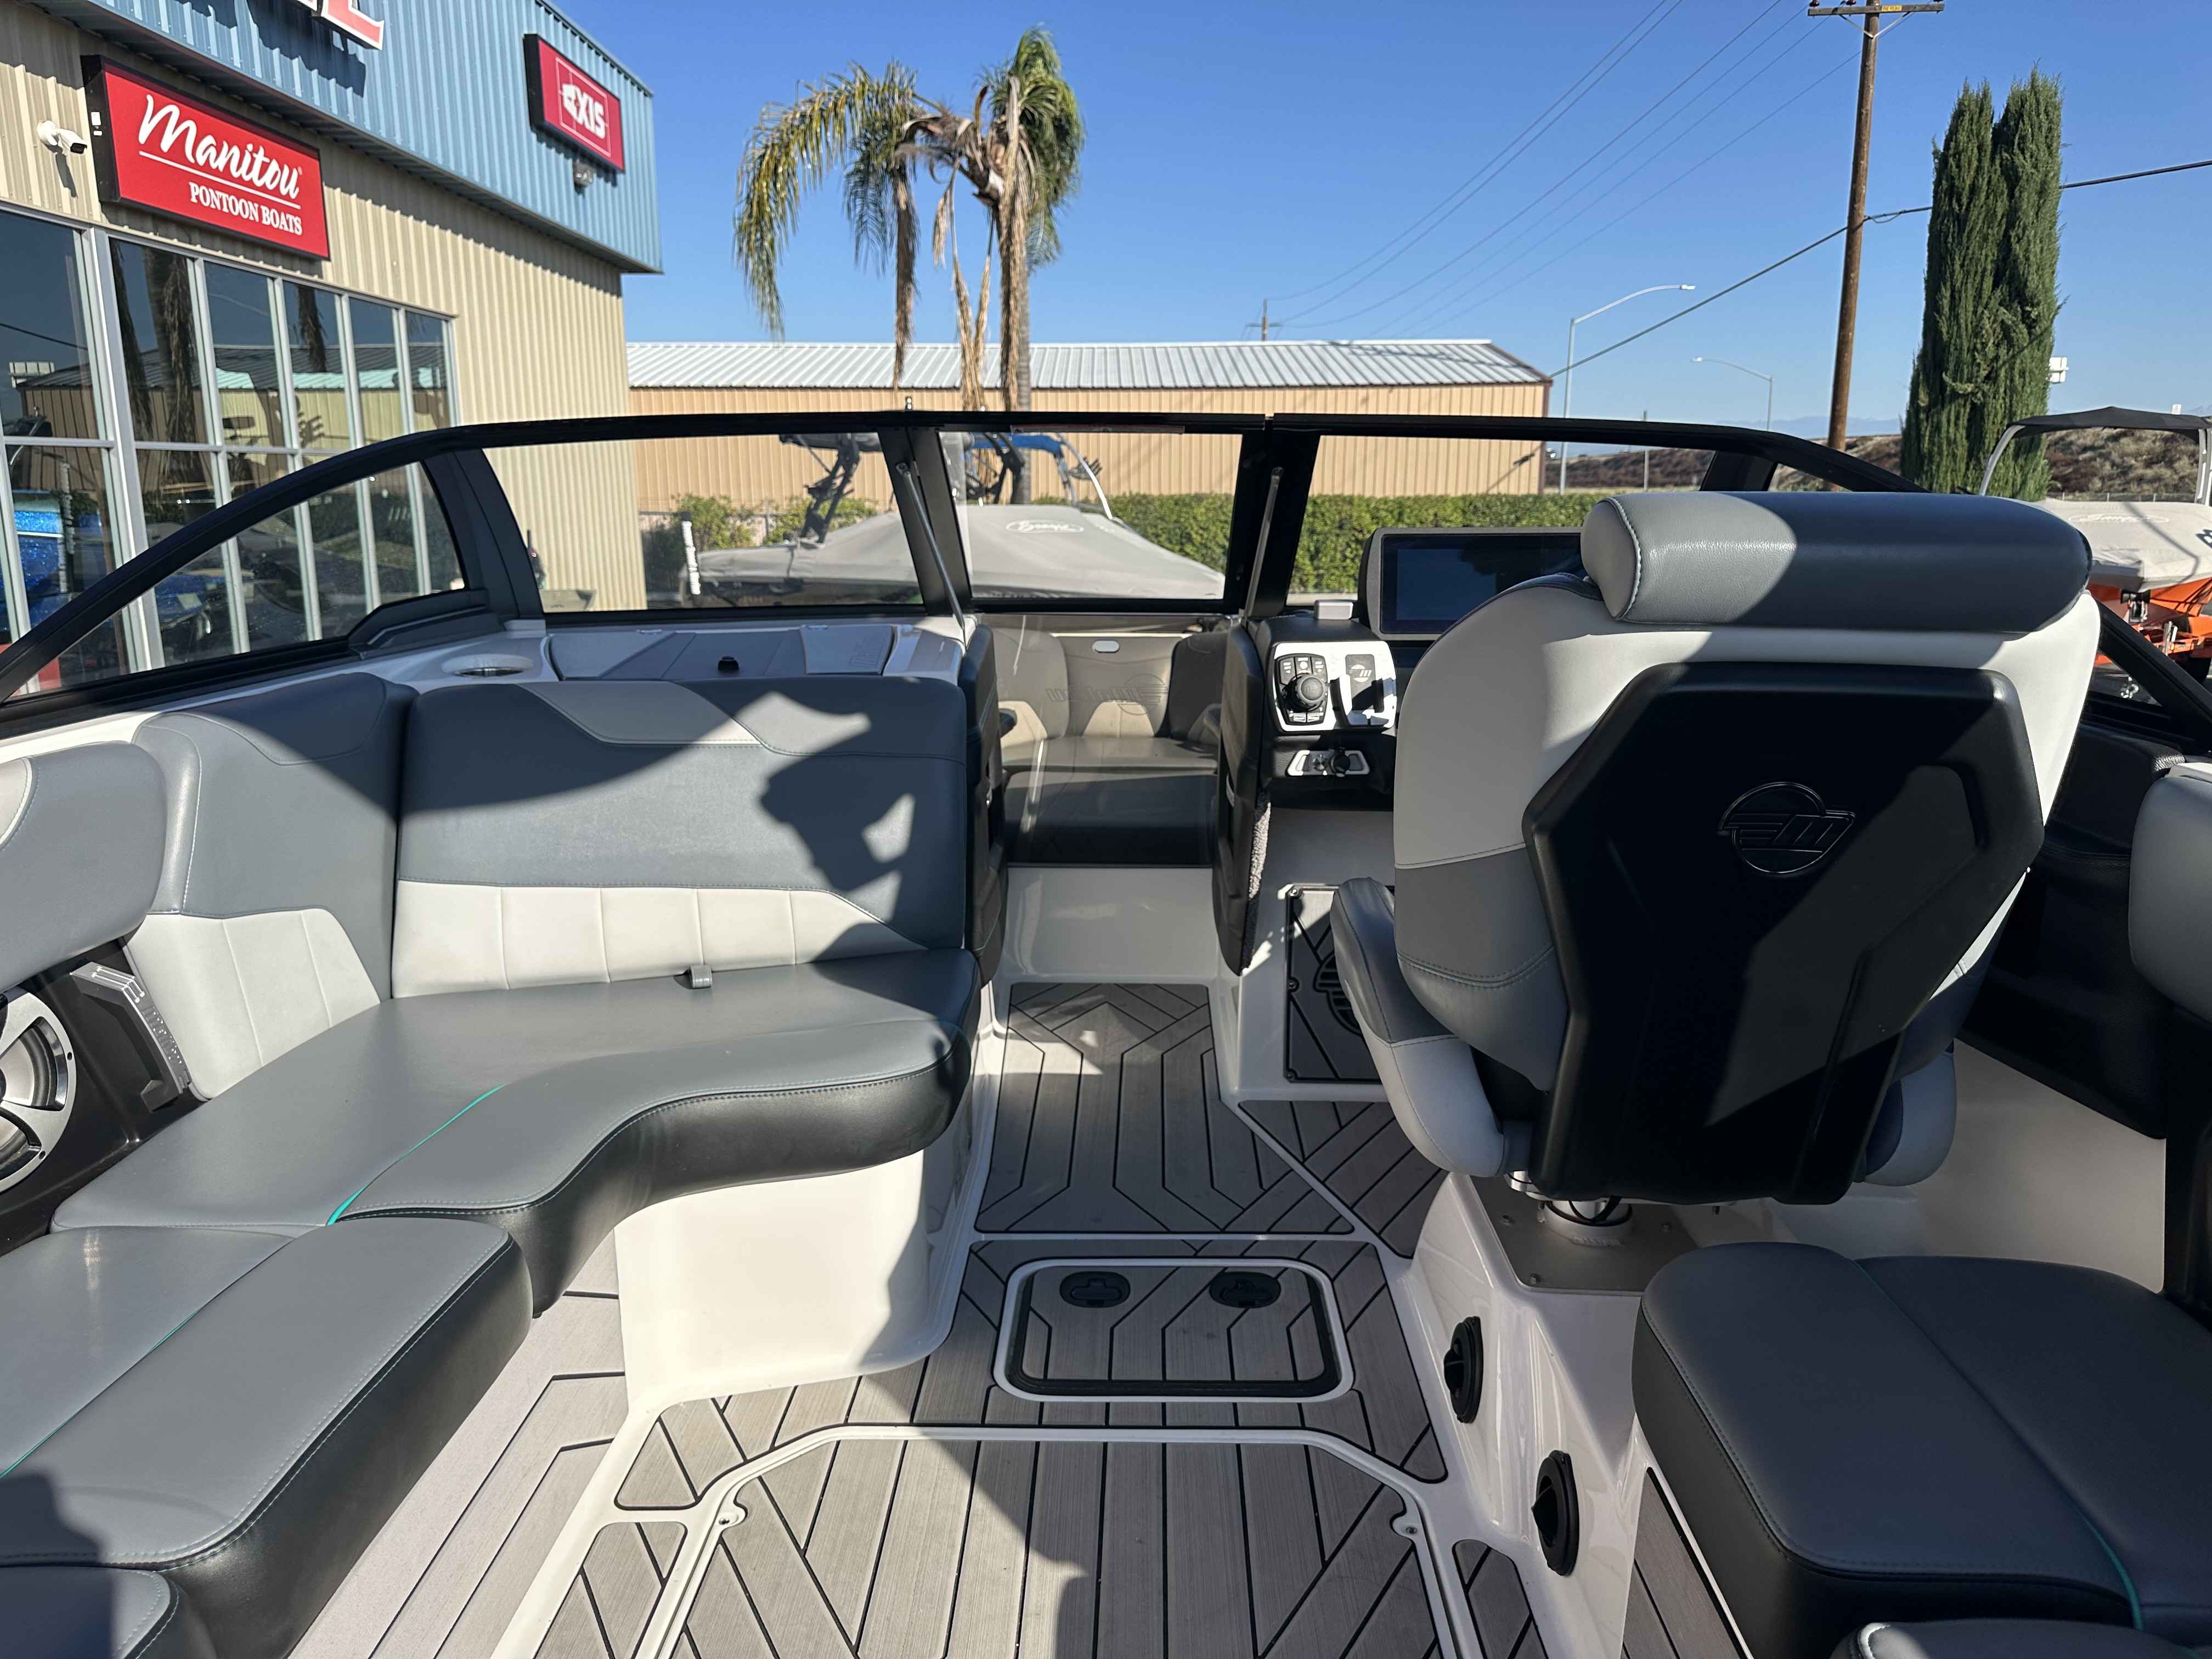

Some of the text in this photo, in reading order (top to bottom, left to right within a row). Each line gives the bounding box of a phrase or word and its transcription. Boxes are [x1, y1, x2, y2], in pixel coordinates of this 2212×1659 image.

[562, 83, 606, 139] AXIS
[138, 94, 301, 200] Manitou
[188, 182, 303, 236] PONTOON BOATS
